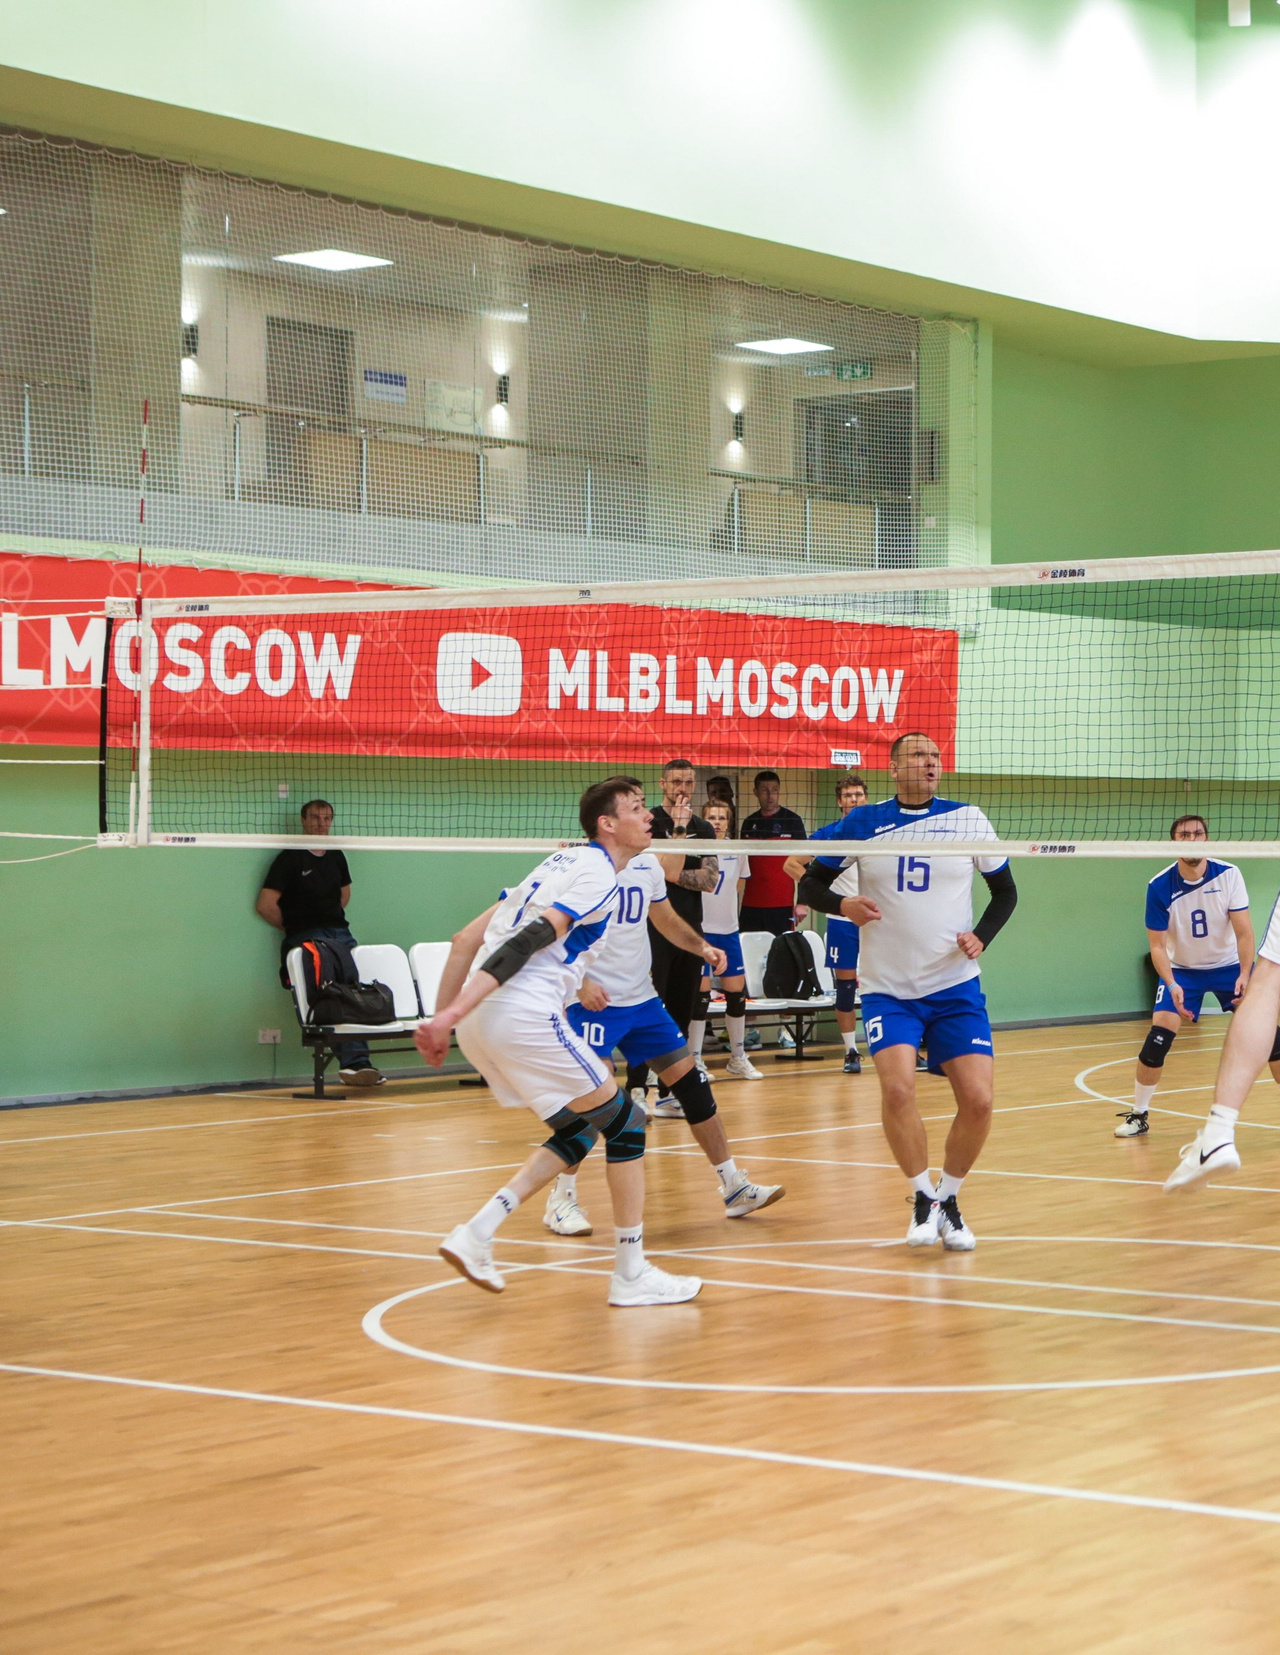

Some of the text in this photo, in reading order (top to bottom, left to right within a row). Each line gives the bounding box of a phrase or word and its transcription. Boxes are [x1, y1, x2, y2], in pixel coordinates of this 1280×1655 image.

[1, 612, 361, 700] LMOSCOW
[548, 648, 905, 724] MLBLMOSCOW
[895, 856, 931, 892] 15
[616, 886, 644, 924] 10
[1191, 909, 1209, 938] 8
[830, 946, 838, 963] 4
[581, 1021, 605, 1047] 10
